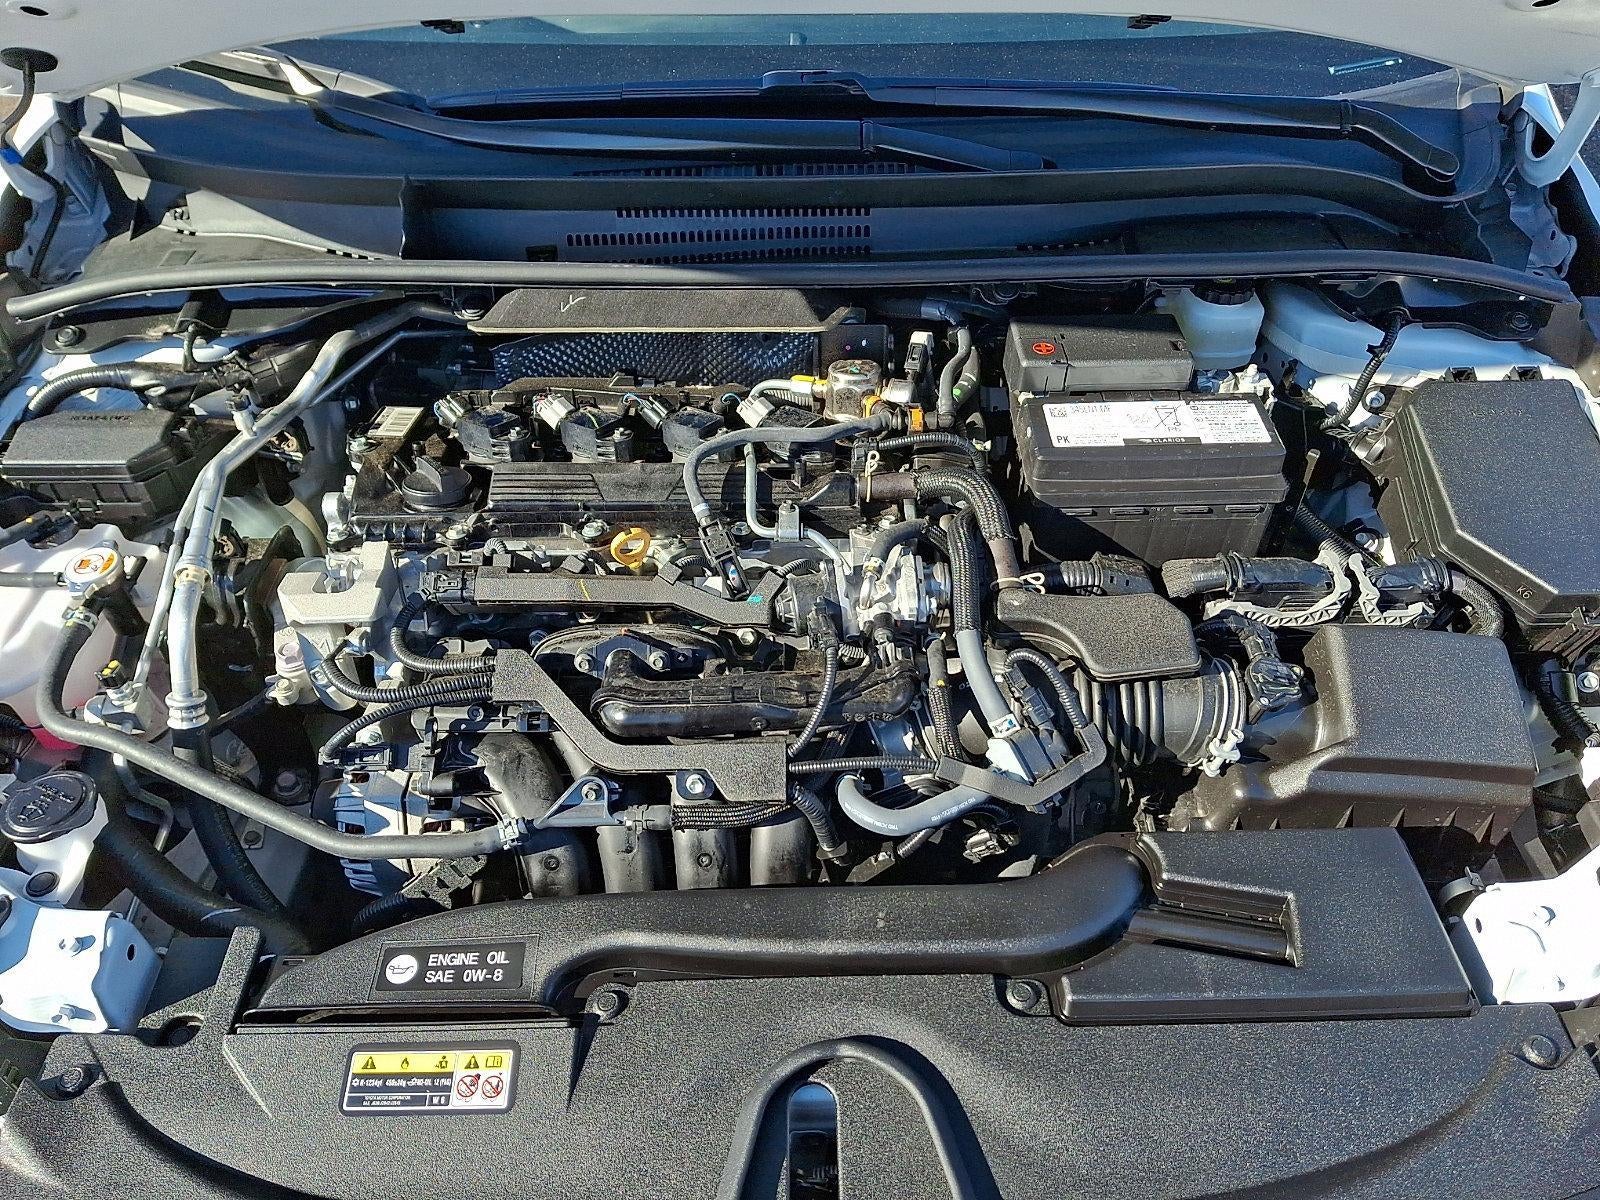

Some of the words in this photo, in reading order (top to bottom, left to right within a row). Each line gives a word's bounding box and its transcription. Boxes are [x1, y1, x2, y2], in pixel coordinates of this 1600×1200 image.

[1056, 435, 1070, 444] PK
[1516, 585, 1533, 599] K6
[427, 952, 480, 967] ENGINE
[486, 950, 510, 965] OIL
[424, 969, 455, 984] SAE
[462, 968, 504, 983] 0W-8
